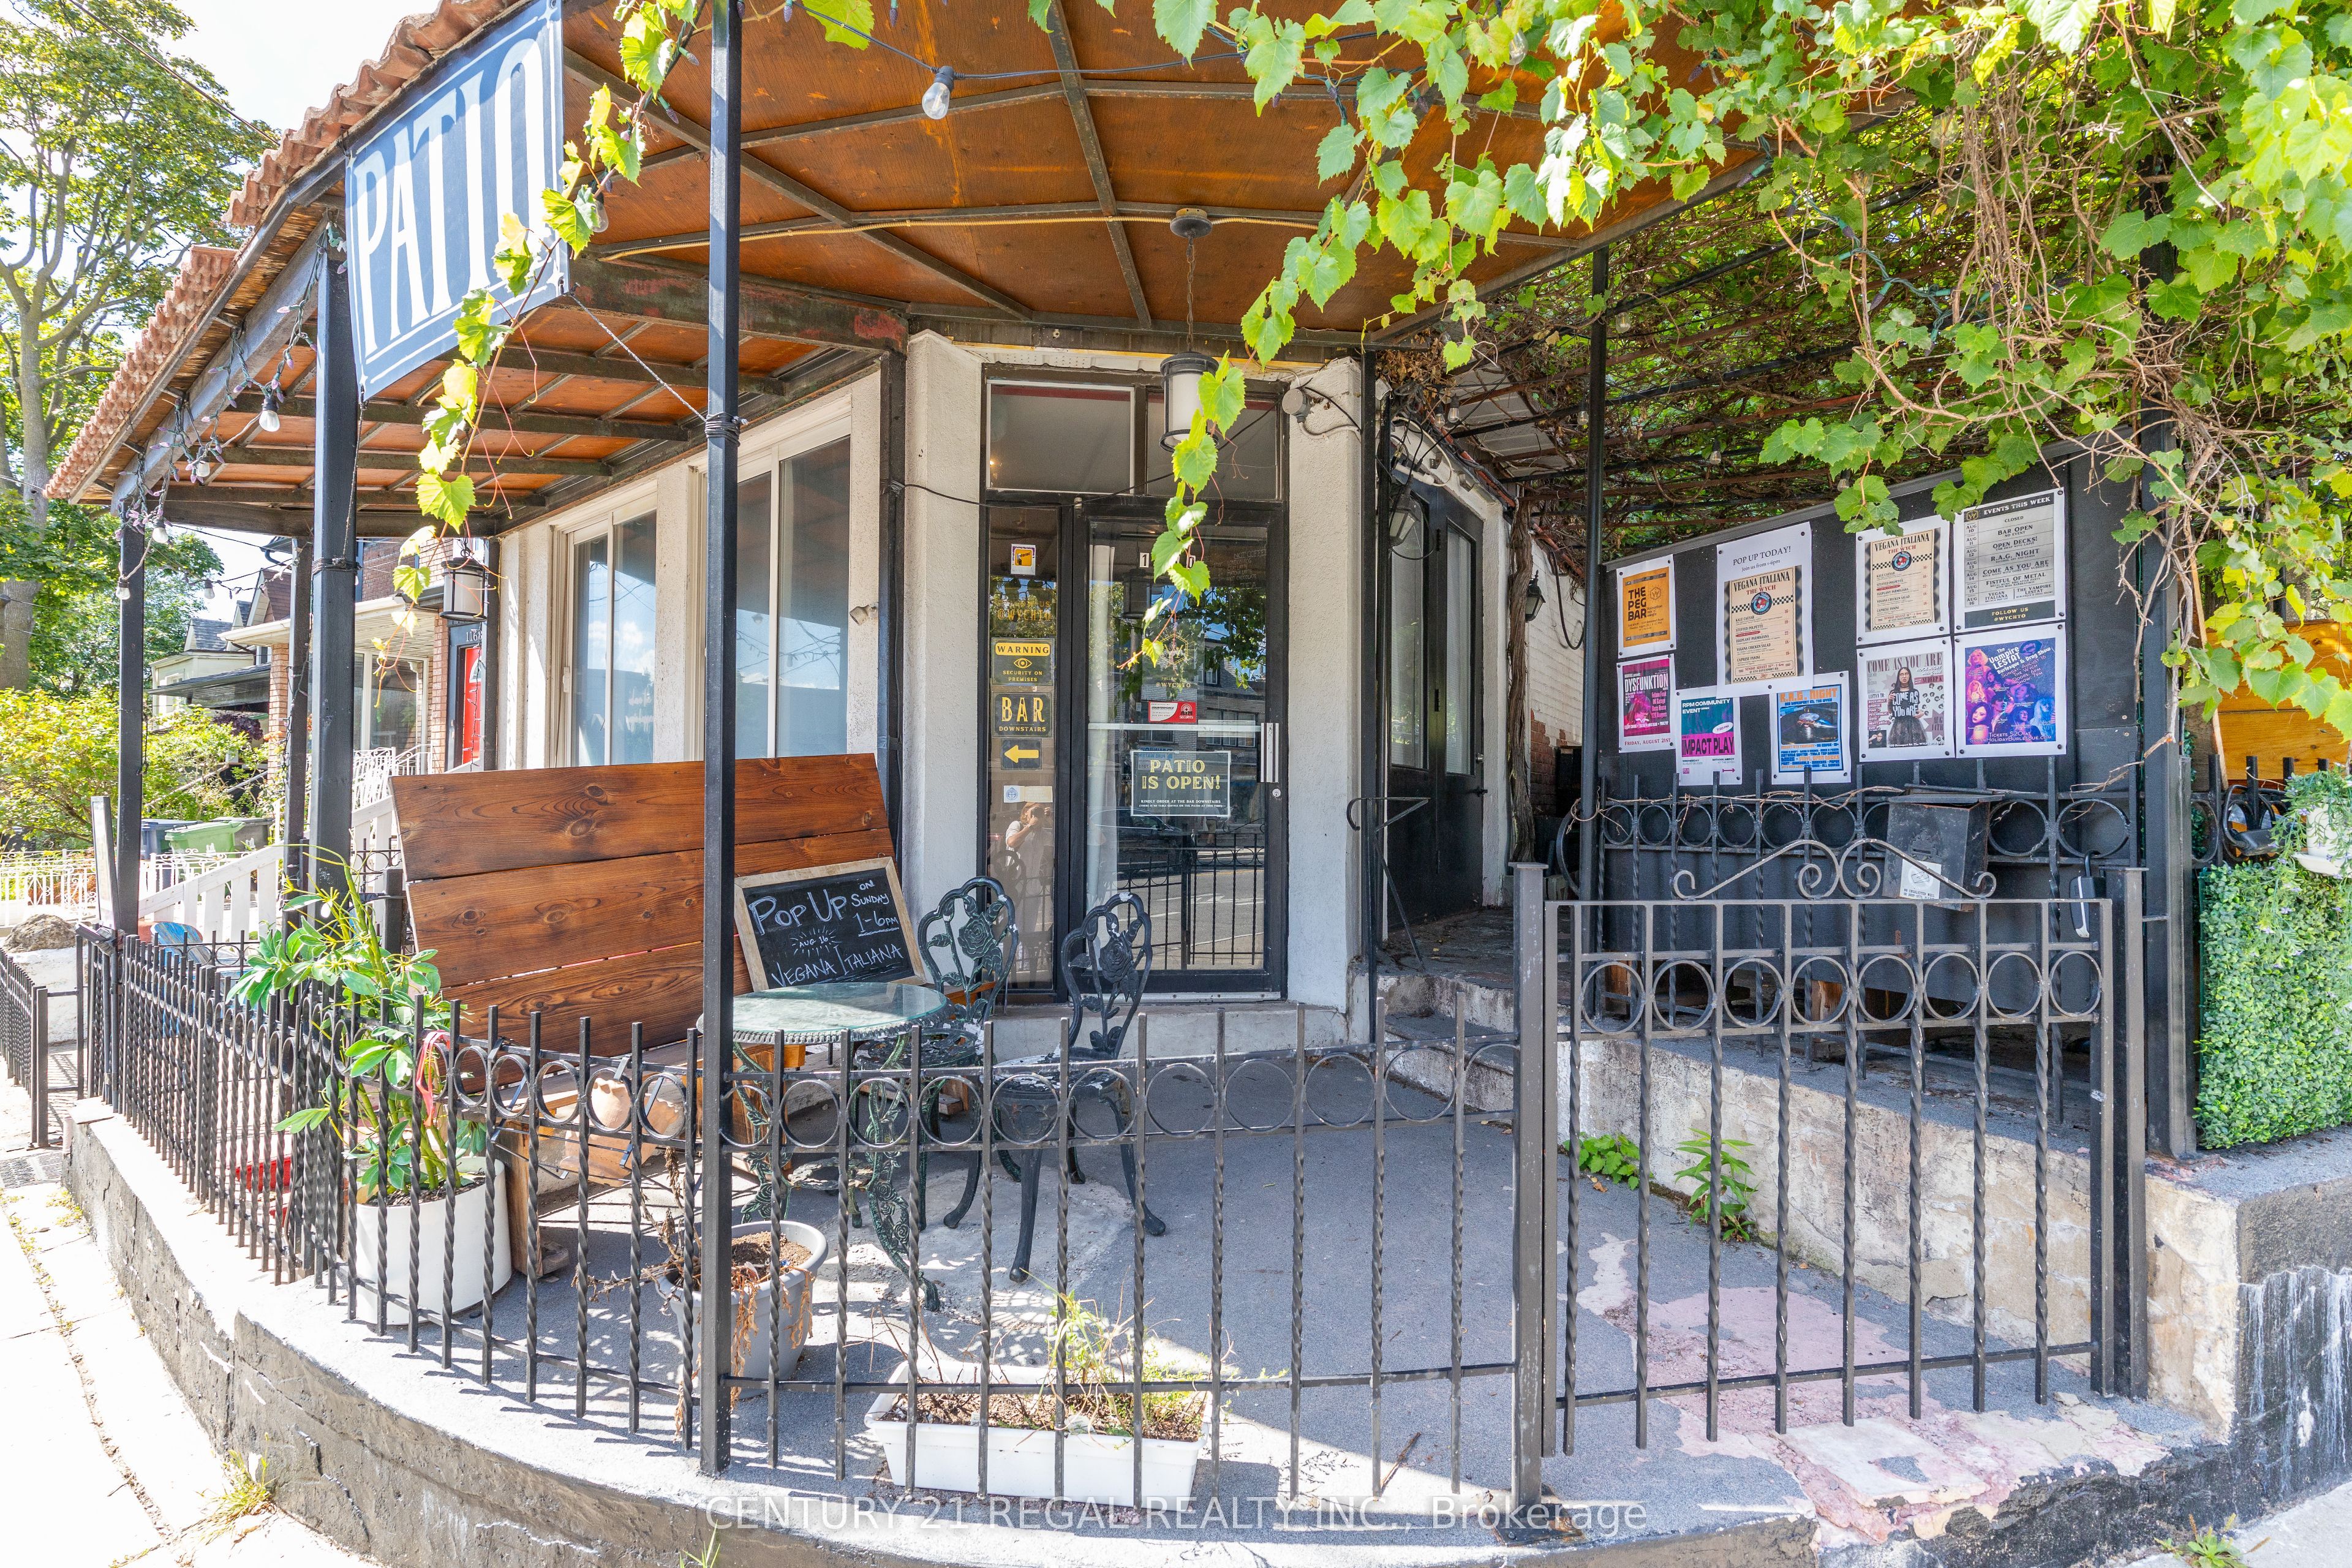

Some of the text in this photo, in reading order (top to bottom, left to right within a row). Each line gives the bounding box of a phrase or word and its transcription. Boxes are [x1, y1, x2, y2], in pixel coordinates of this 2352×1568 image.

[354, 38, 553, 356] PATIO
[1984, 506, 2009, 515] EVENTS
[2030, 497, 2051, 505] WEEK
[1875, 533, 1929, 552] VEGANA ITALIANA
[2013, 537, 2037, 545] DECKS!
[1733, 557, 1747, 565] POP
[1760, 546, 1791, 559] TODAY!
[1733, 571, 1790, 592] VEGANA ITALIANA
[1628, 586, 1646, 600] THE
[1628, 597, 1646, 610] PEG
[1628, 608, 1646, 621] BAR
[466, 630, 482, 642] 1168
[1868, 652, 1943, 674] COME AS YOU ARE
[1989, 646, 2019, 664] Vampire
[1993, 652, 2021, 670] LESTAT
[1997, 662, 2019, 674] Burlesque
[2038, 647, 2051, 656] Show
[1624, 673, 1668, 693] DYSFUNKTION
[1780, 688, 1838, 702] R.A.G. NIGHT
[1893, 691, 1918, 706] COME AS
[1001, 696, 1045, 722] BAR
[1893, 706, 1905, 717] YOU
[1682, 737, 1734, 755] IMPACT PLAY
[1150, 760, 1205, 773] PATIO
[1142, 775, 1220, 790] IS OPEN!
[859, 880, 875, 891] ON
[807, 889, 847, 922] UP
[851, 893, 889, 907] SUNDAY
[771, 943, 904, 987] VEGANA ITALIANA
